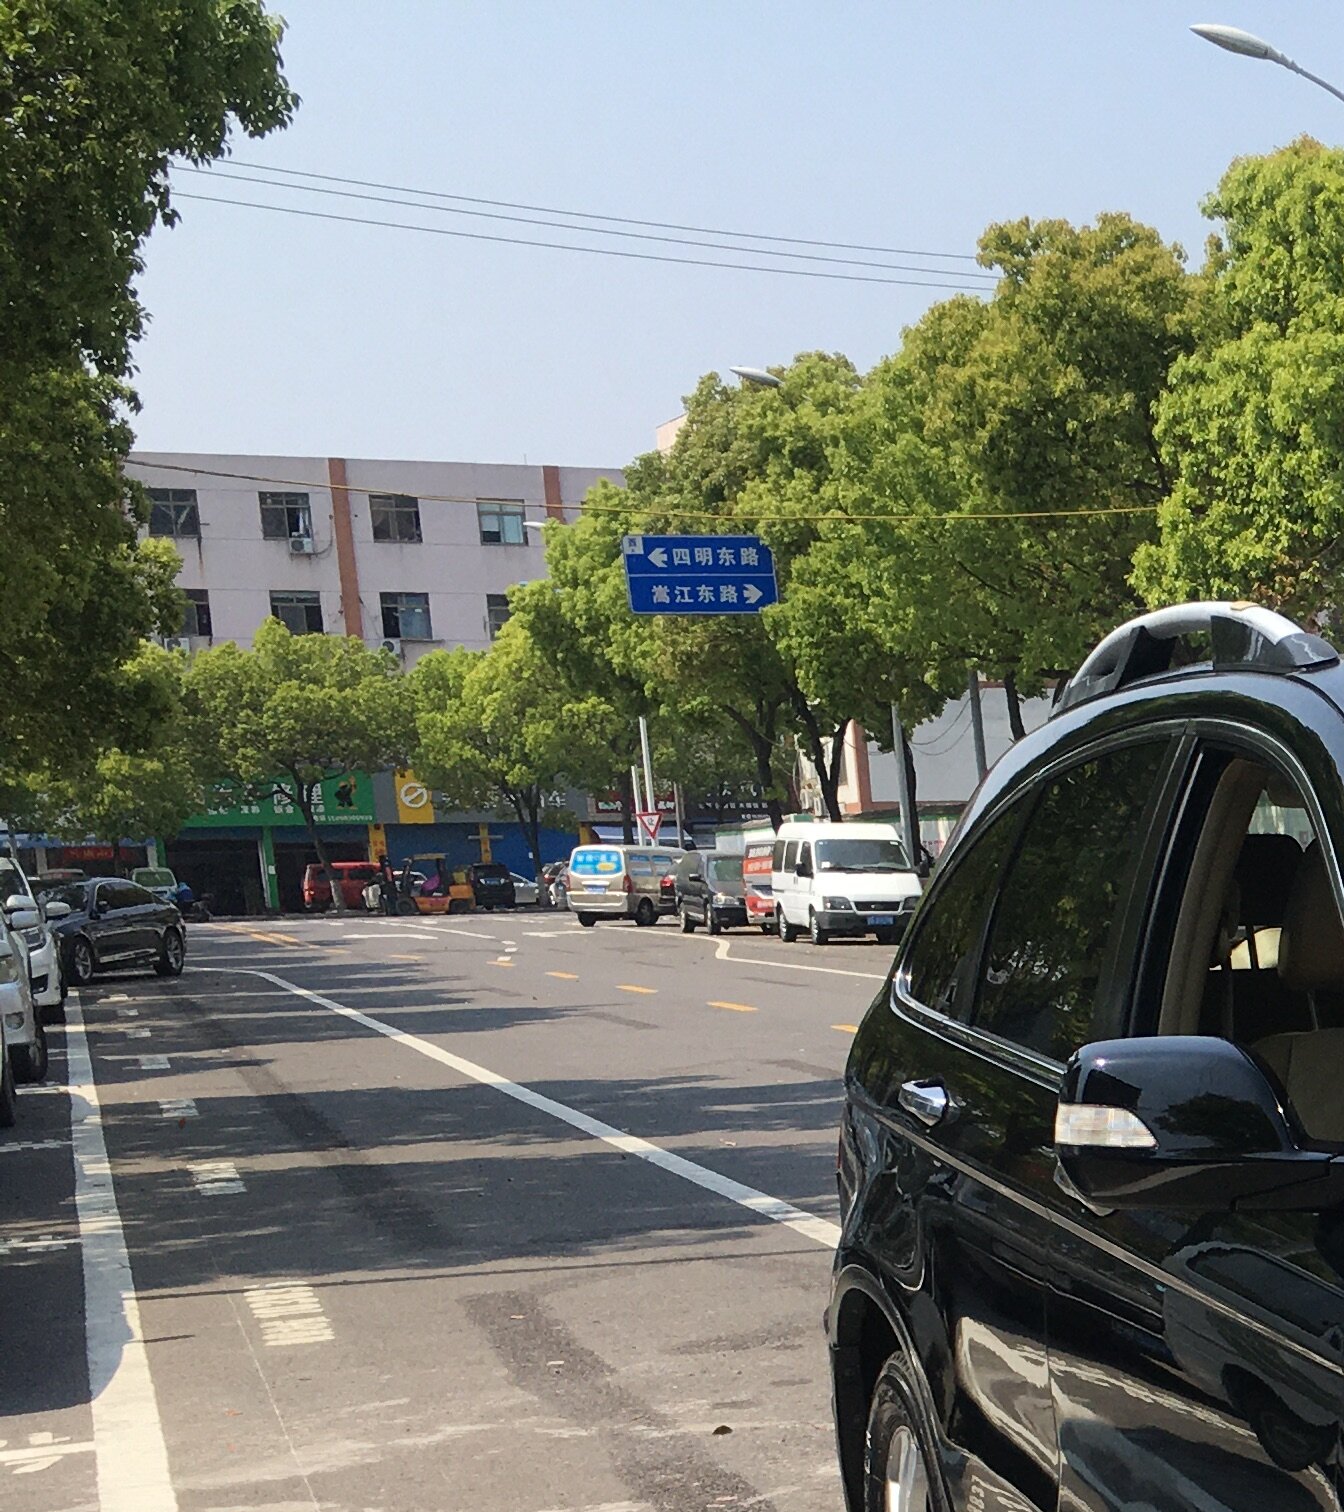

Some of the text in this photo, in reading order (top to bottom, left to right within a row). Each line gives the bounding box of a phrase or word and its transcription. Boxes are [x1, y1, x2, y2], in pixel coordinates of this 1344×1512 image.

[672, 547, 759, 566] 四明东路
[652, 584, 738, 604] 嵩江东路
